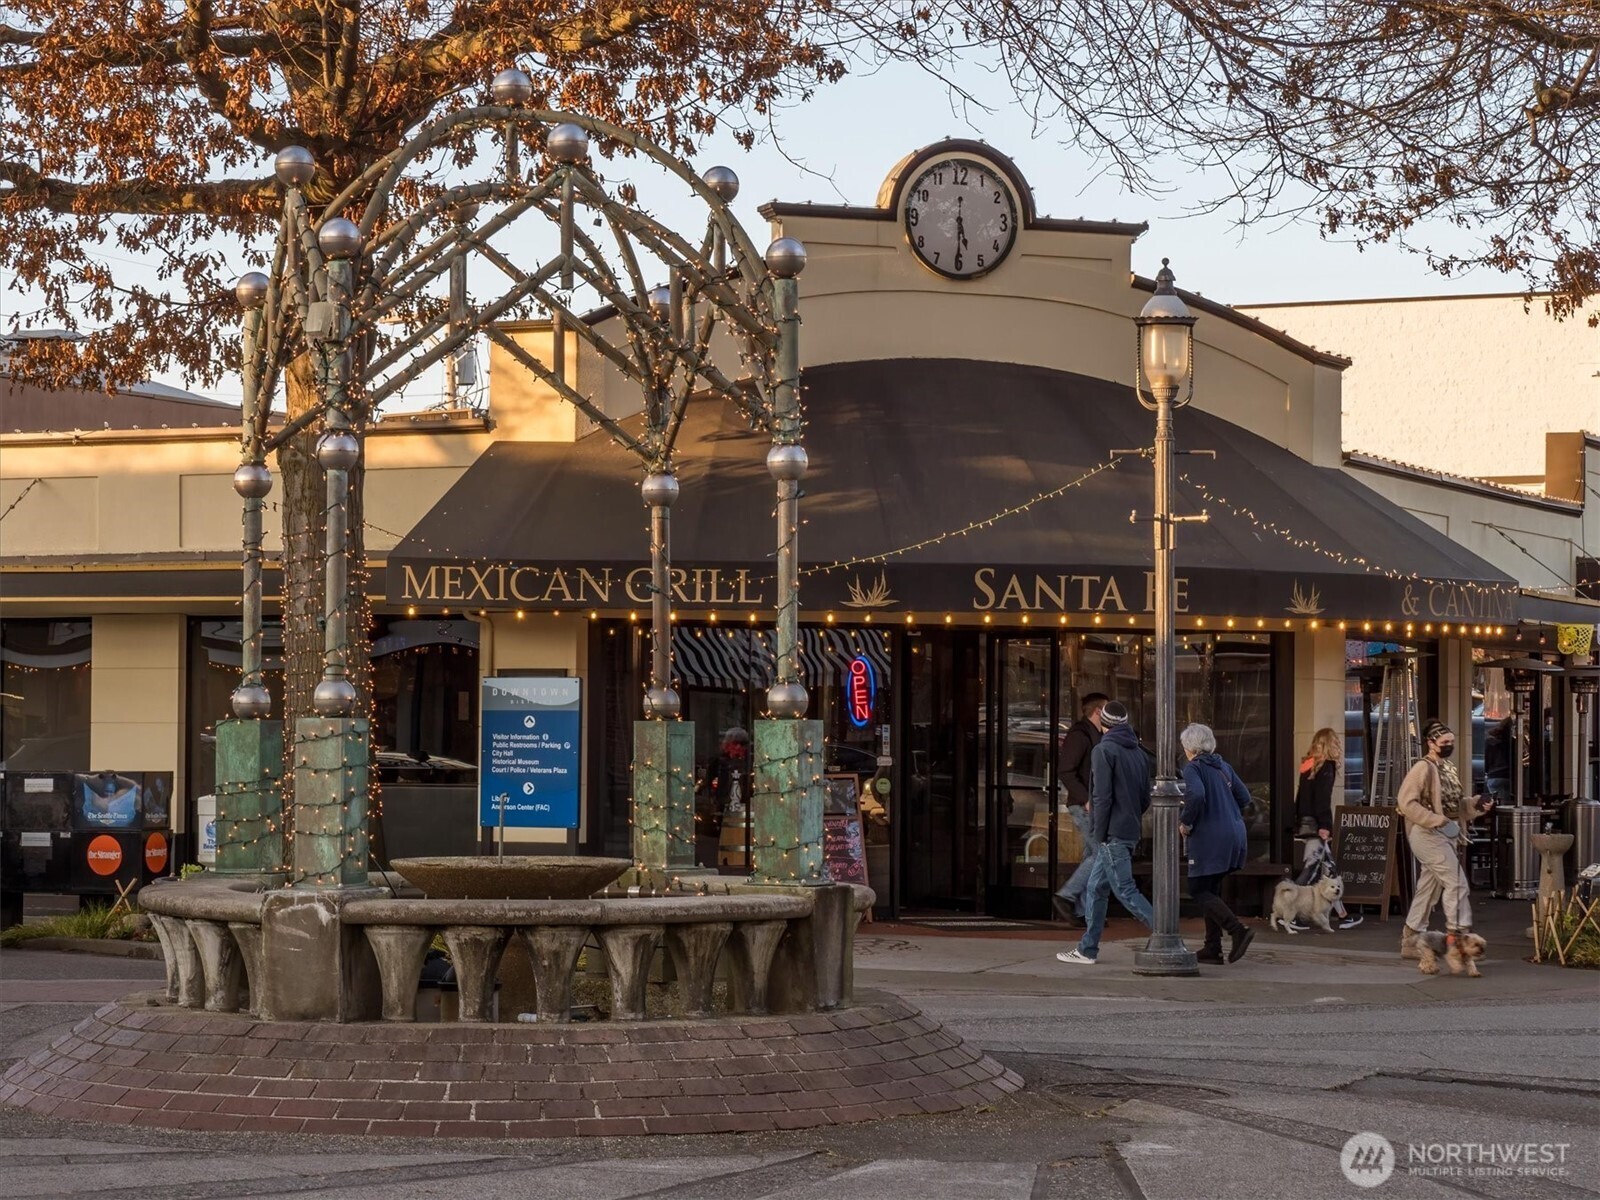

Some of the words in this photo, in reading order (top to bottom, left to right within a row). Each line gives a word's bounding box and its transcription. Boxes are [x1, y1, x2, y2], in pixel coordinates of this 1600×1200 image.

[933, 172, 943, 186] 11
[952, 167, 968, 186] 12
[979, 174, 985, 187] 1
[917, 189, 929, 203] 10
[993, 191, 1001, 204] 2
[910, 208, 919, 227] 9
[999, 214, 1008, 232] 3
[917, 235, 925, 249] 8
[992, 239, 1000, 253] 4
[933, 252, 941, 265] 7
[954, 253, 963, 271] 6
[977, 254, 985, 267] 5
[401, 565, 613, 602] MEXICAN
[625, 567, 763, 603] GRILL
[973, 567, 1128, 611] SANTA
[1401, 583, 1420, 616] &
[1428, 584, 1515, 620] CANTINA
[492, 687, 569, 697] DOWNTOWN
[851, 659, 870, 720] OPEN
[541, 742, 561, 750] Parking
[530, 767, 552, 775] Veterans
[491, 795, 511, 803] Libry
[535, 804, 551, 812] (FAC)
[1340, 813, 1390, 828] BIENVENIDOS
